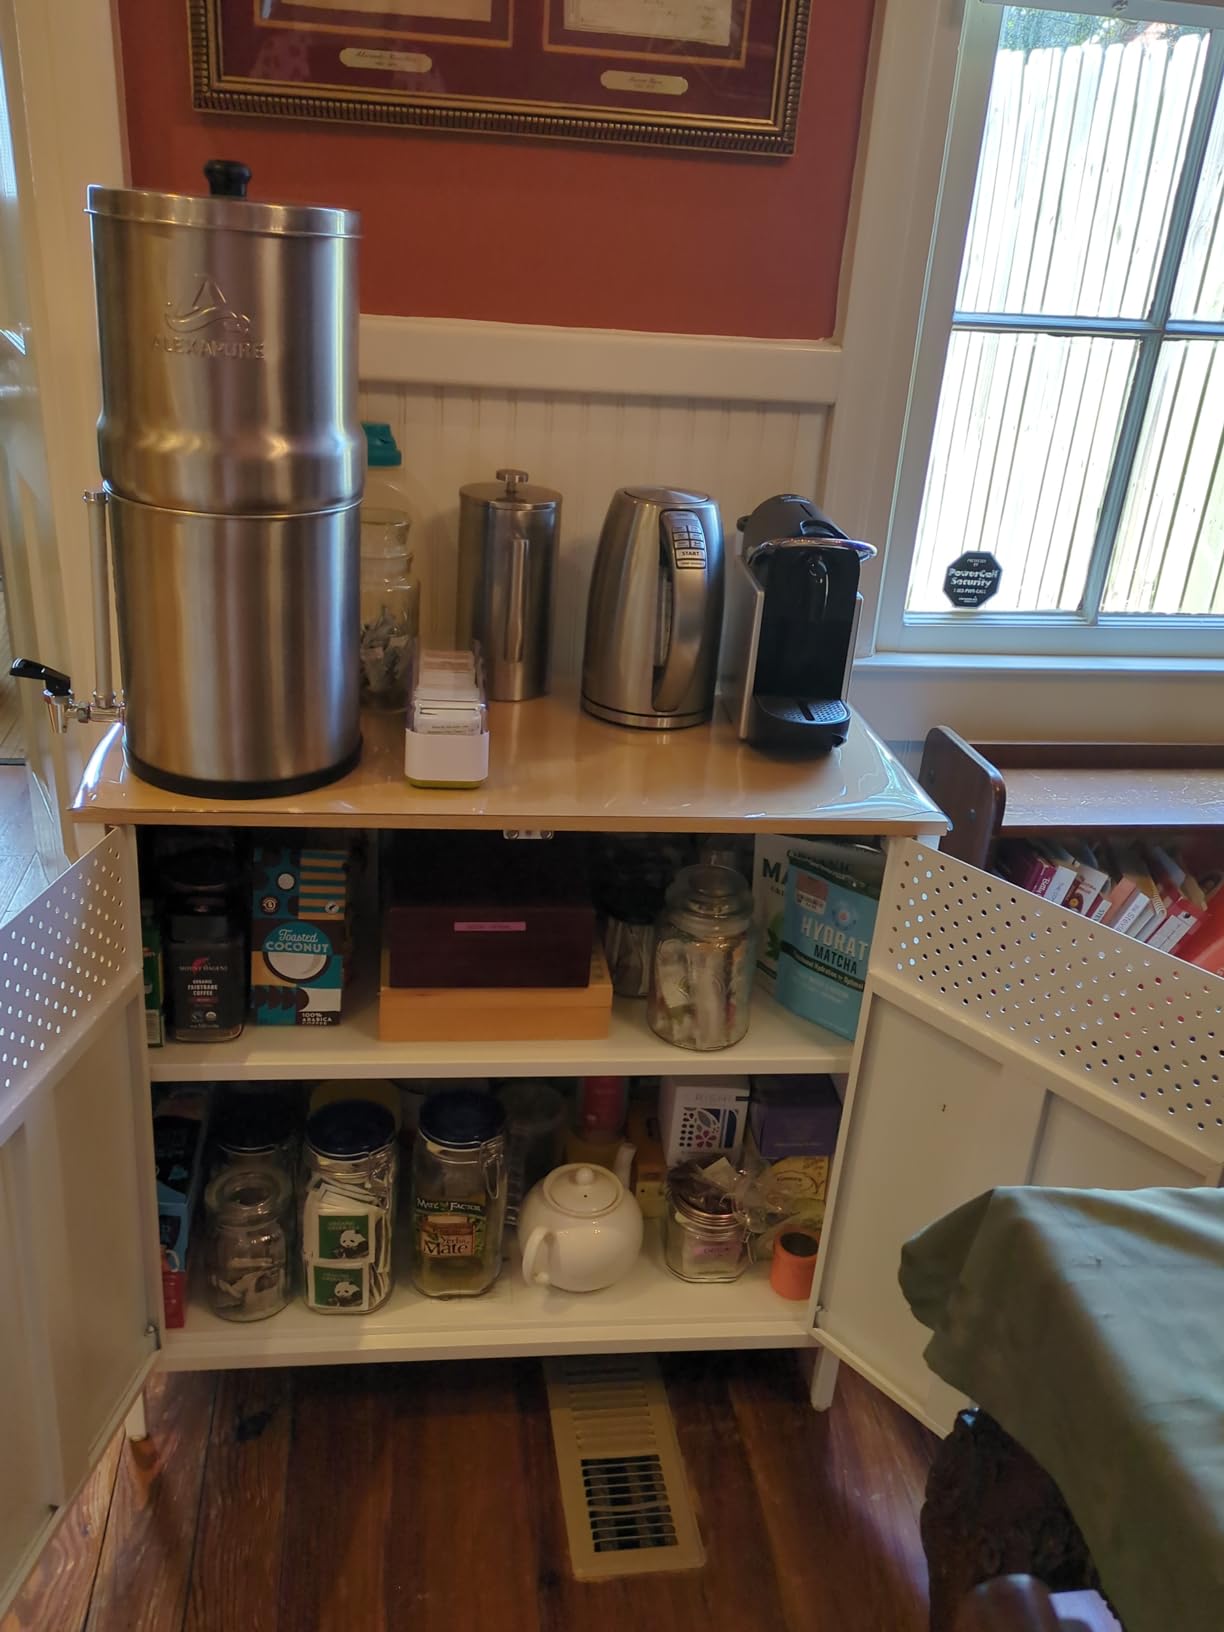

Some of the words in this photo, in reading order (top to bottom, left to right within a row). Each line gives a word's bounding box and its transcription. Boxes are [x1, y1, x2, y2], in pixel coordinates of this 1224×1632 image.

[153, 336, 265, 359] ALEXAPURE
[950, 577, 992, 588] Security
[278, 928, 318, 942] Toasted
[265, 941, 329, 953] COCONUT
[813, 944, 858, 974] MATCHA
